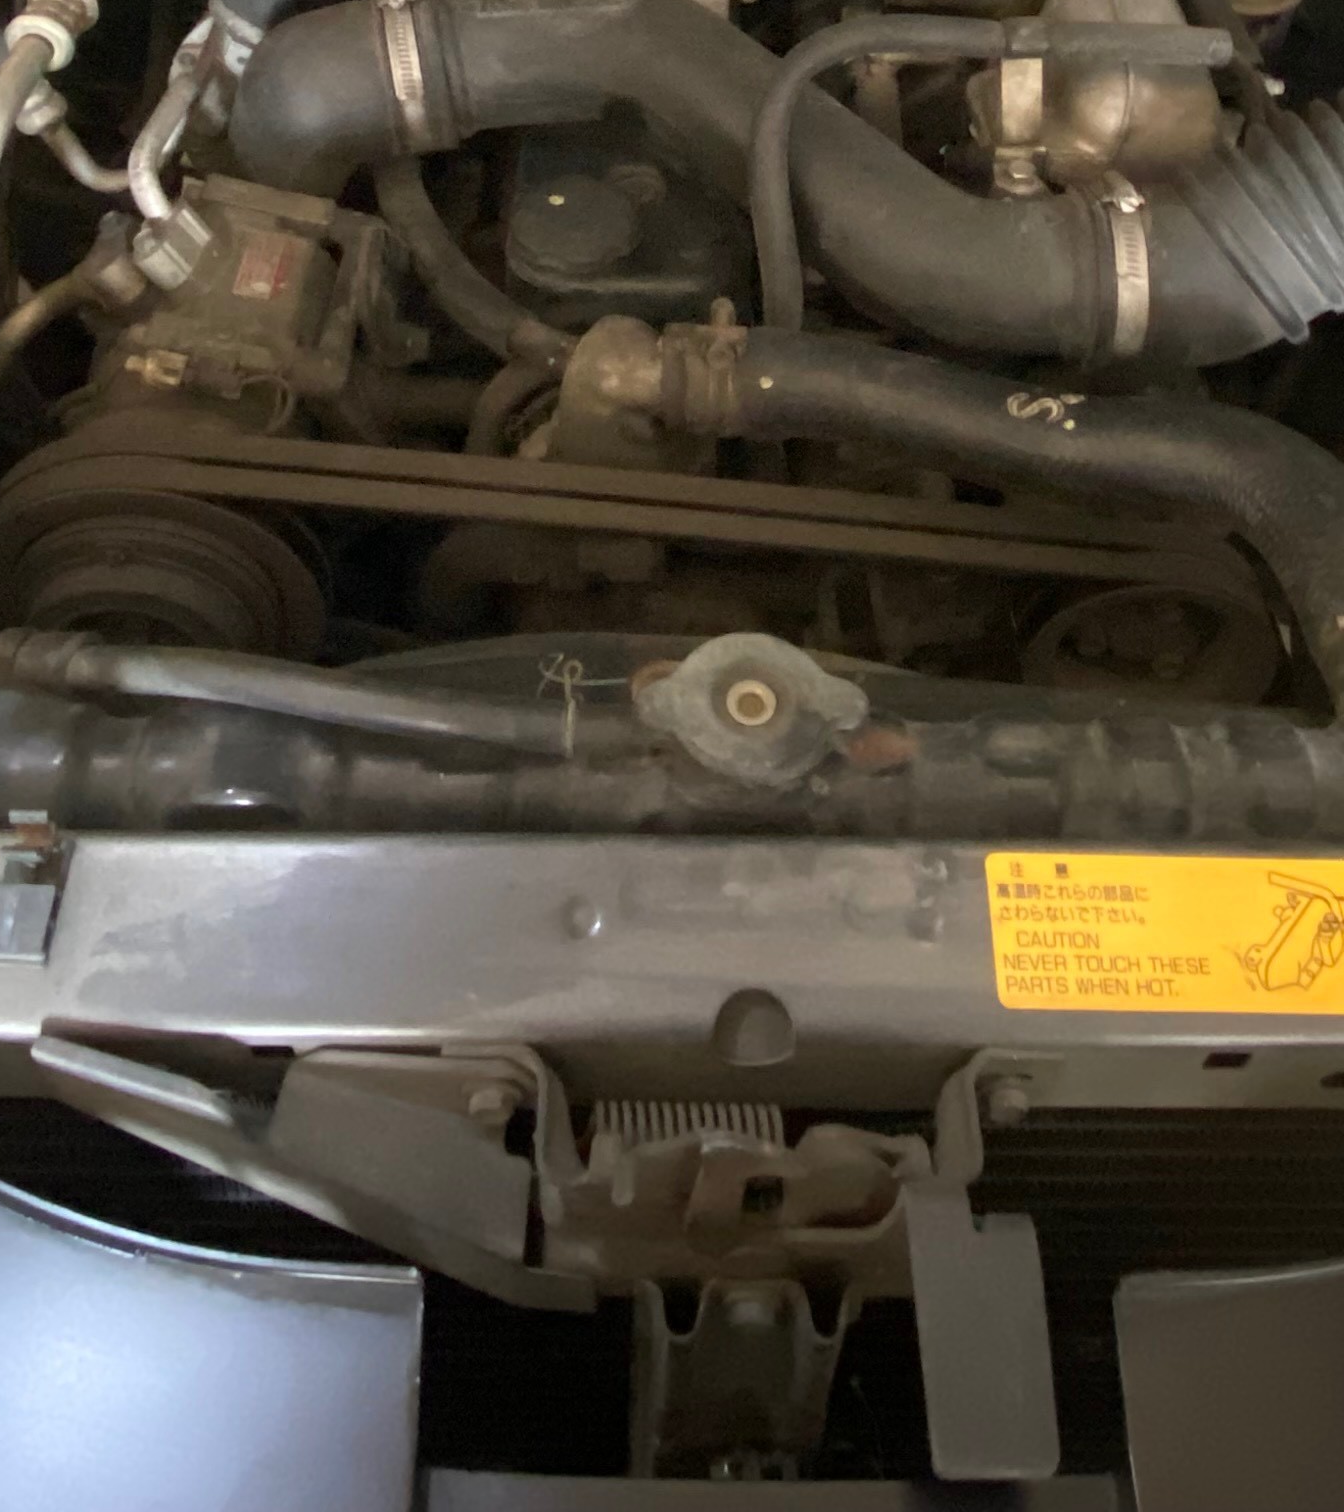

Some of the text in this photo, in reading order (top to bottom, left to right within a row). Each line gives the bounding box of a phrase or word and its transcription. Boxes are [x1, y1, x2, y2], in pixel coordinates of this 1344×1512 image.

[1016, 930, 1100, 949] CAUTION
[1002, 953, 1211, 975] NEVER TOUCH THESE
[1006, 976, 1180, 997] PARTS WHEN HOT.
